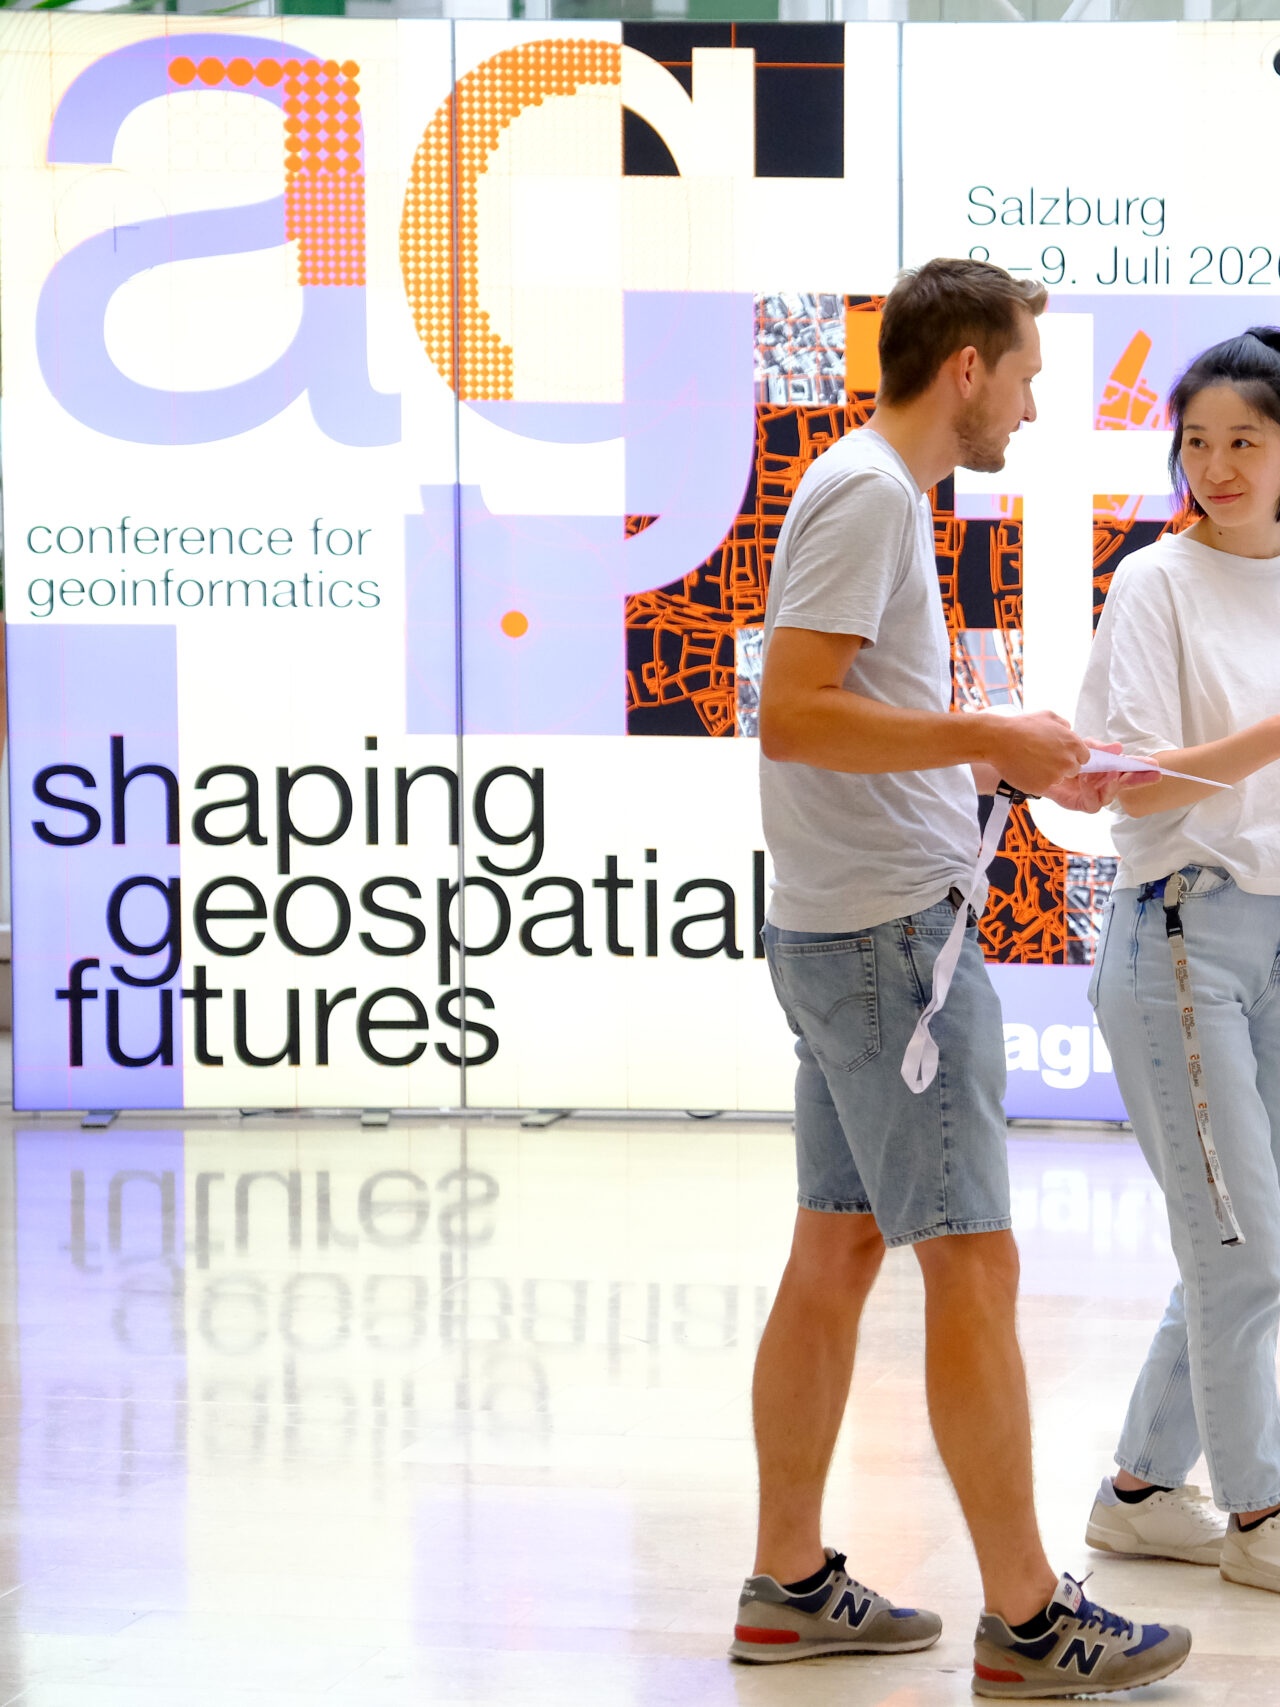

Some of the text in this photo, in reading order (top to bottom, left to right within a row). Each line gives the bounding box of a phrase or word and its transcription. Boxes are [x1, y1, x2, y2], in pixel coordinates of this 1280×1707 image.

[967, 185, 1166, 237] Salzburg
[967, 245, 1077, 286] –9.
[1095, 245, 1171, 286] Juli
[26, 515, 373, 556] conference for
[26, 567, 382, 618] geoinformatics
[31, 735, 546, 877] shaping
[104, 848, 766, 987] geospatial
[55, 957, 500, 1068] futures
[828, 1588, 873, 1629] N
[1055, 1636, 1107, 1677] N
